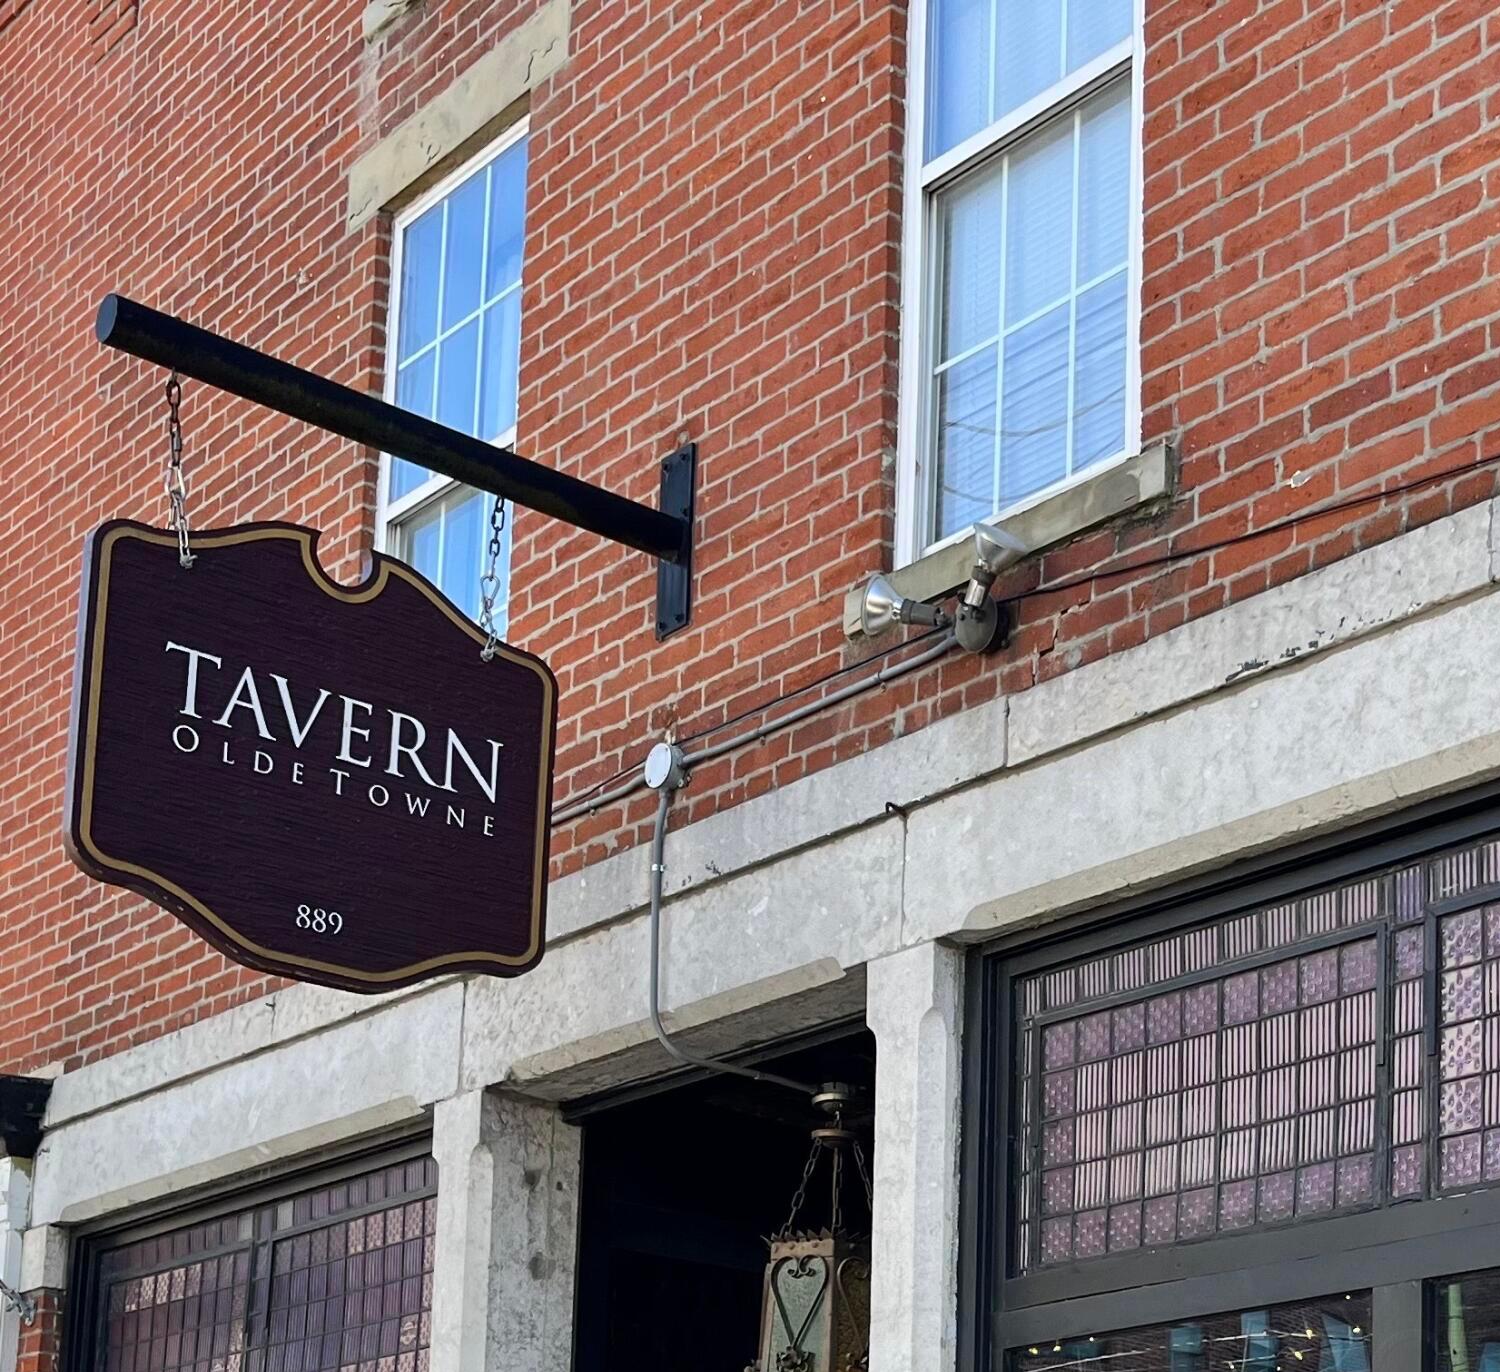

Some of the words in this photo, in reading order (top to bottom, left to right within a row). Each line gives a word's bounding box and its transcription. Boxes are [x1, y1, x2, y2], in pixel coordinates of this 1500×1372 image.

[164, 640, 504, 804] TAVERN
[172, 724, 304, 785] OLDE
[329, 768, 496, 837] TOWNE
[295, 904, 343, 936] 889
